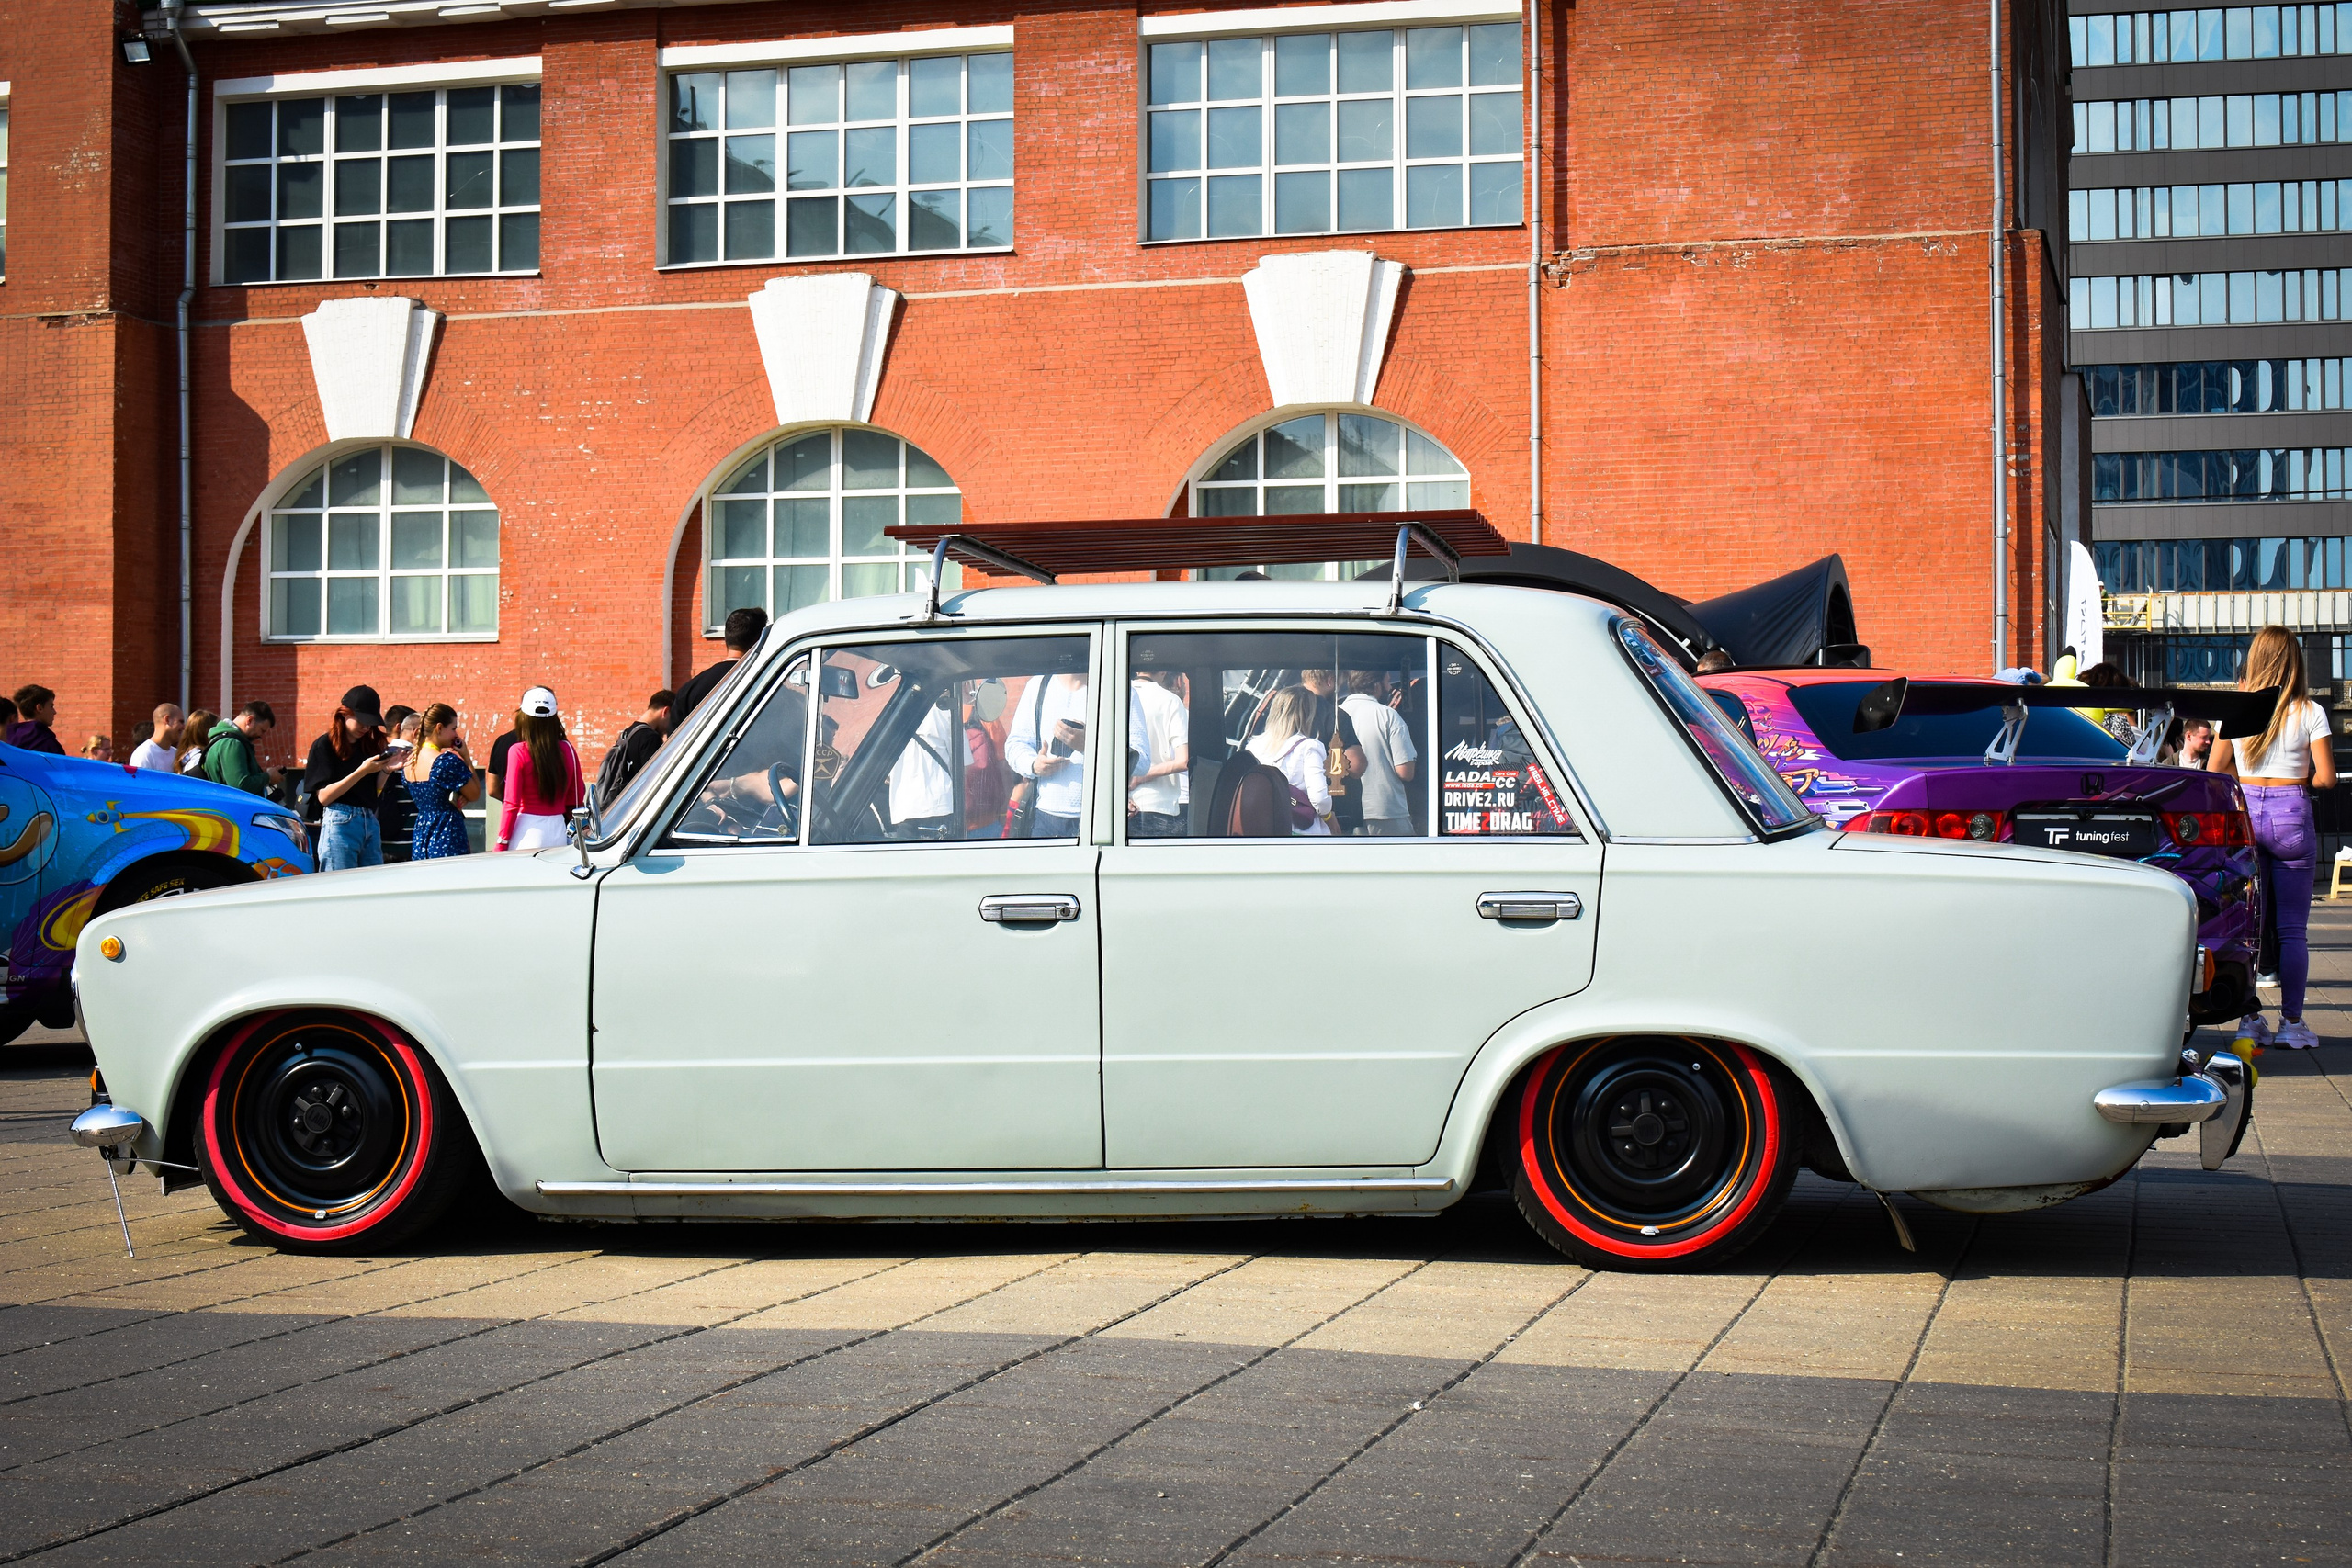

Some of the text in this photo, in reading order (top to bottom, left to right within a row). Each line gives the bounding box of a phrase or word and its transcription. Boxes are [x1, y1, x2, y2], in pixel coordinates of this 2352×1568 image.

[1444, 791, 1515, 807] DRIVE2.RU
[1445, 811, 1533, 831] TIME2DRAG
[2044, 828, 2070, 845] TF
[151, 877, 186, 897] SAFE SEX
